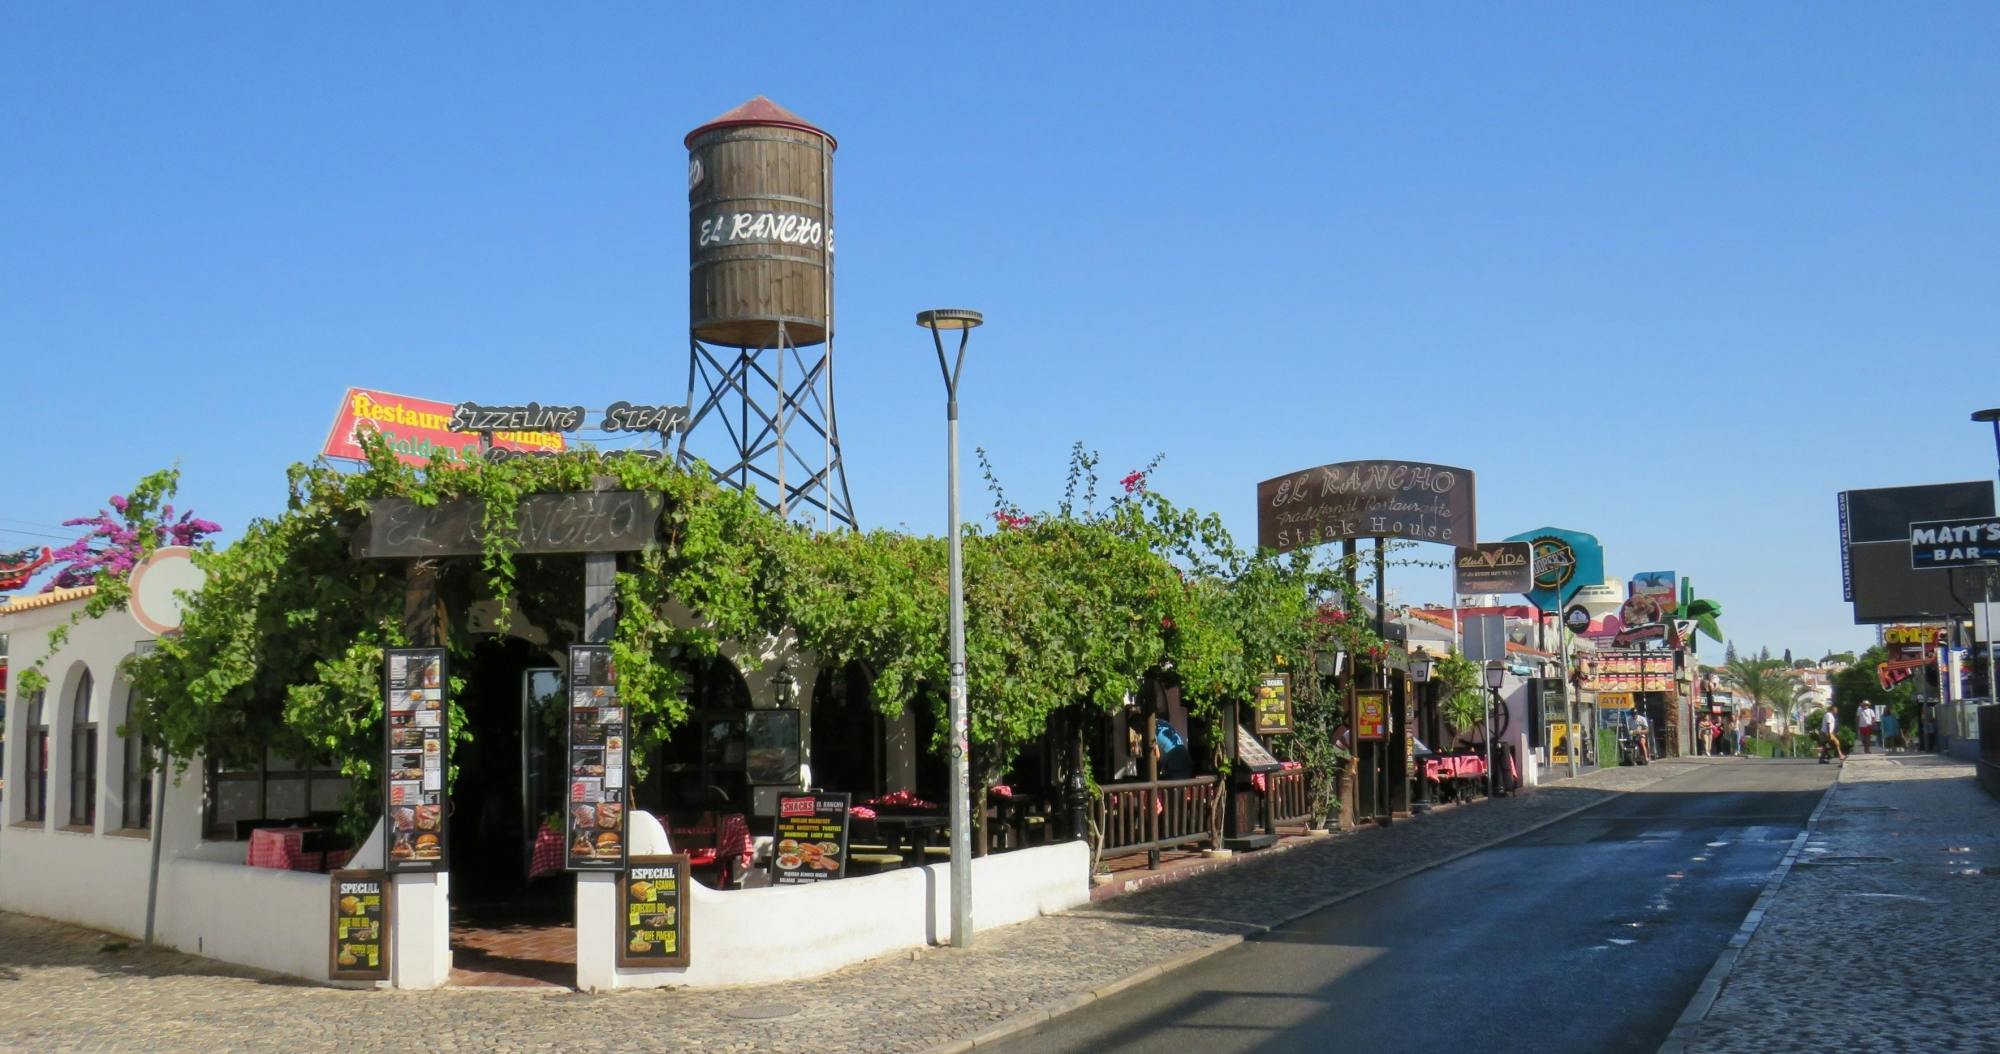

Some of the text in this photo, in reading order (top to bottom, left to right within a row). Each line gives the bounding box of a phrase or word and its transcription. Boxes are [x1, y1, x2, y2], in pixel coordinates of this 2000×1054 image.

[700, 217, 724, 246] EL
[730, 213, 822, 244] RANCHO
[606, 407, 685, 434] STEAK
[1272, 465, 1455, 507] EL RANCHO
[1370, 516, 1452, 540] House
[1934, 547, 1980, 561] BAR
[631, 868, 675, 879] ESPECIAL
[340, 883, 380, 894] SPECIAL
